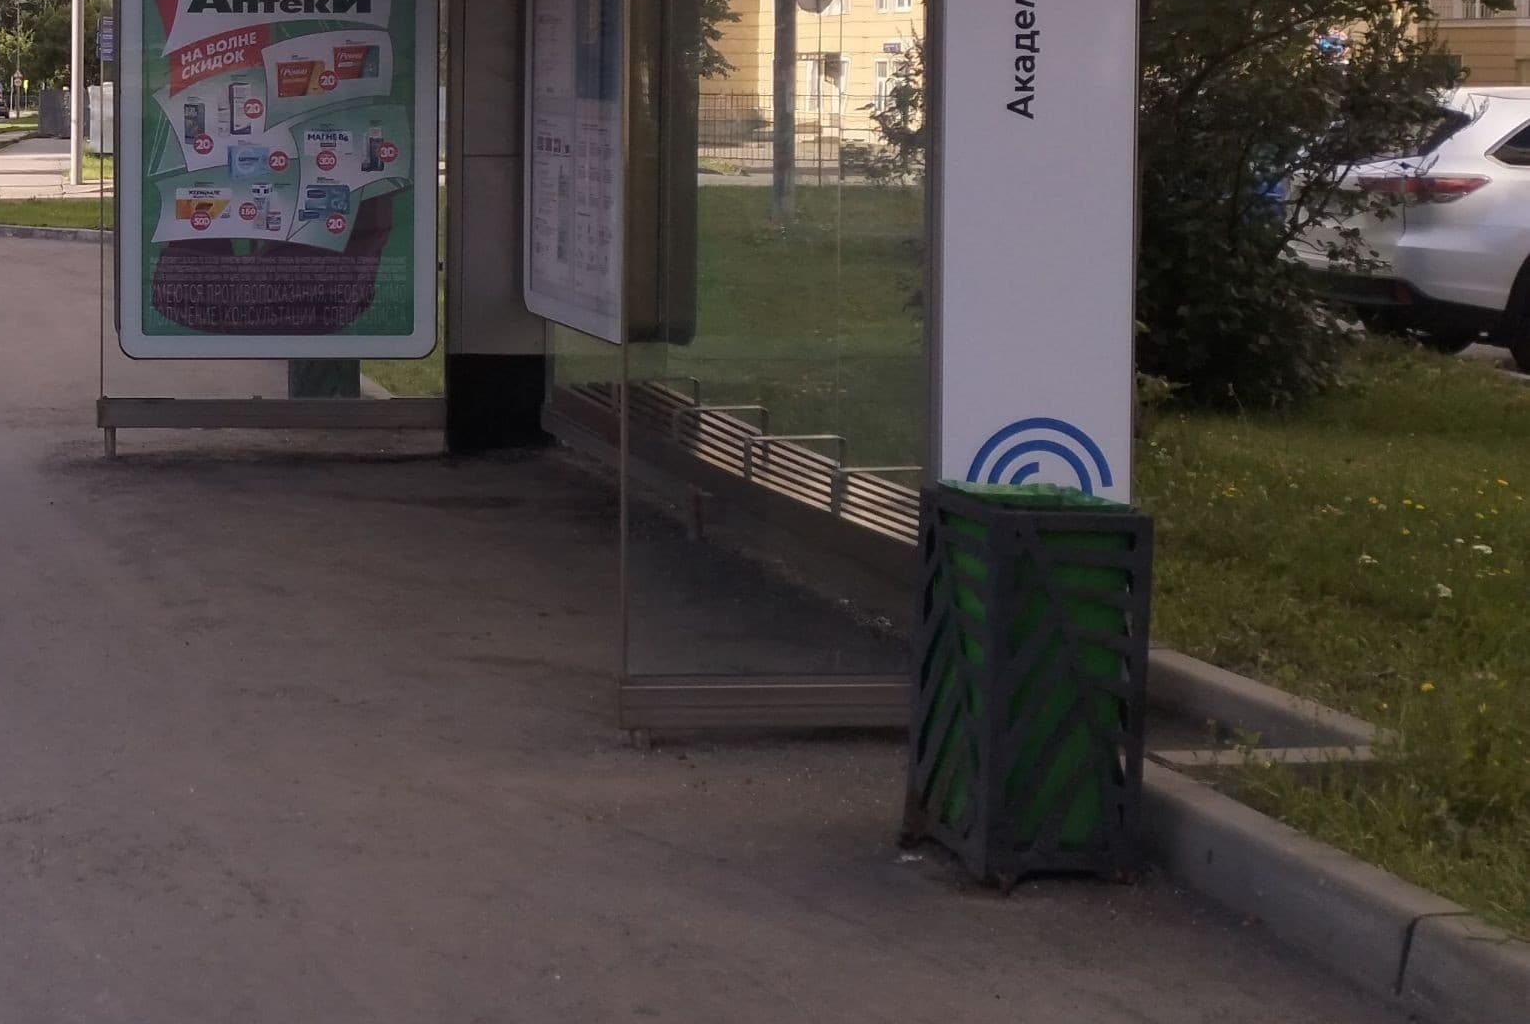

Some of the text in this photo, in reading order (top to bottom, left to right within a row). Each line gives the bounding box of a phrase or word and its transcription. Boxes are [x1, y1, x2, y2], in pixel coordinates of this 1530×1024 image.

[181, 31, 257, 66] НА ВОЛНЕ
[181, 50, 246, 80] СКИДОК
